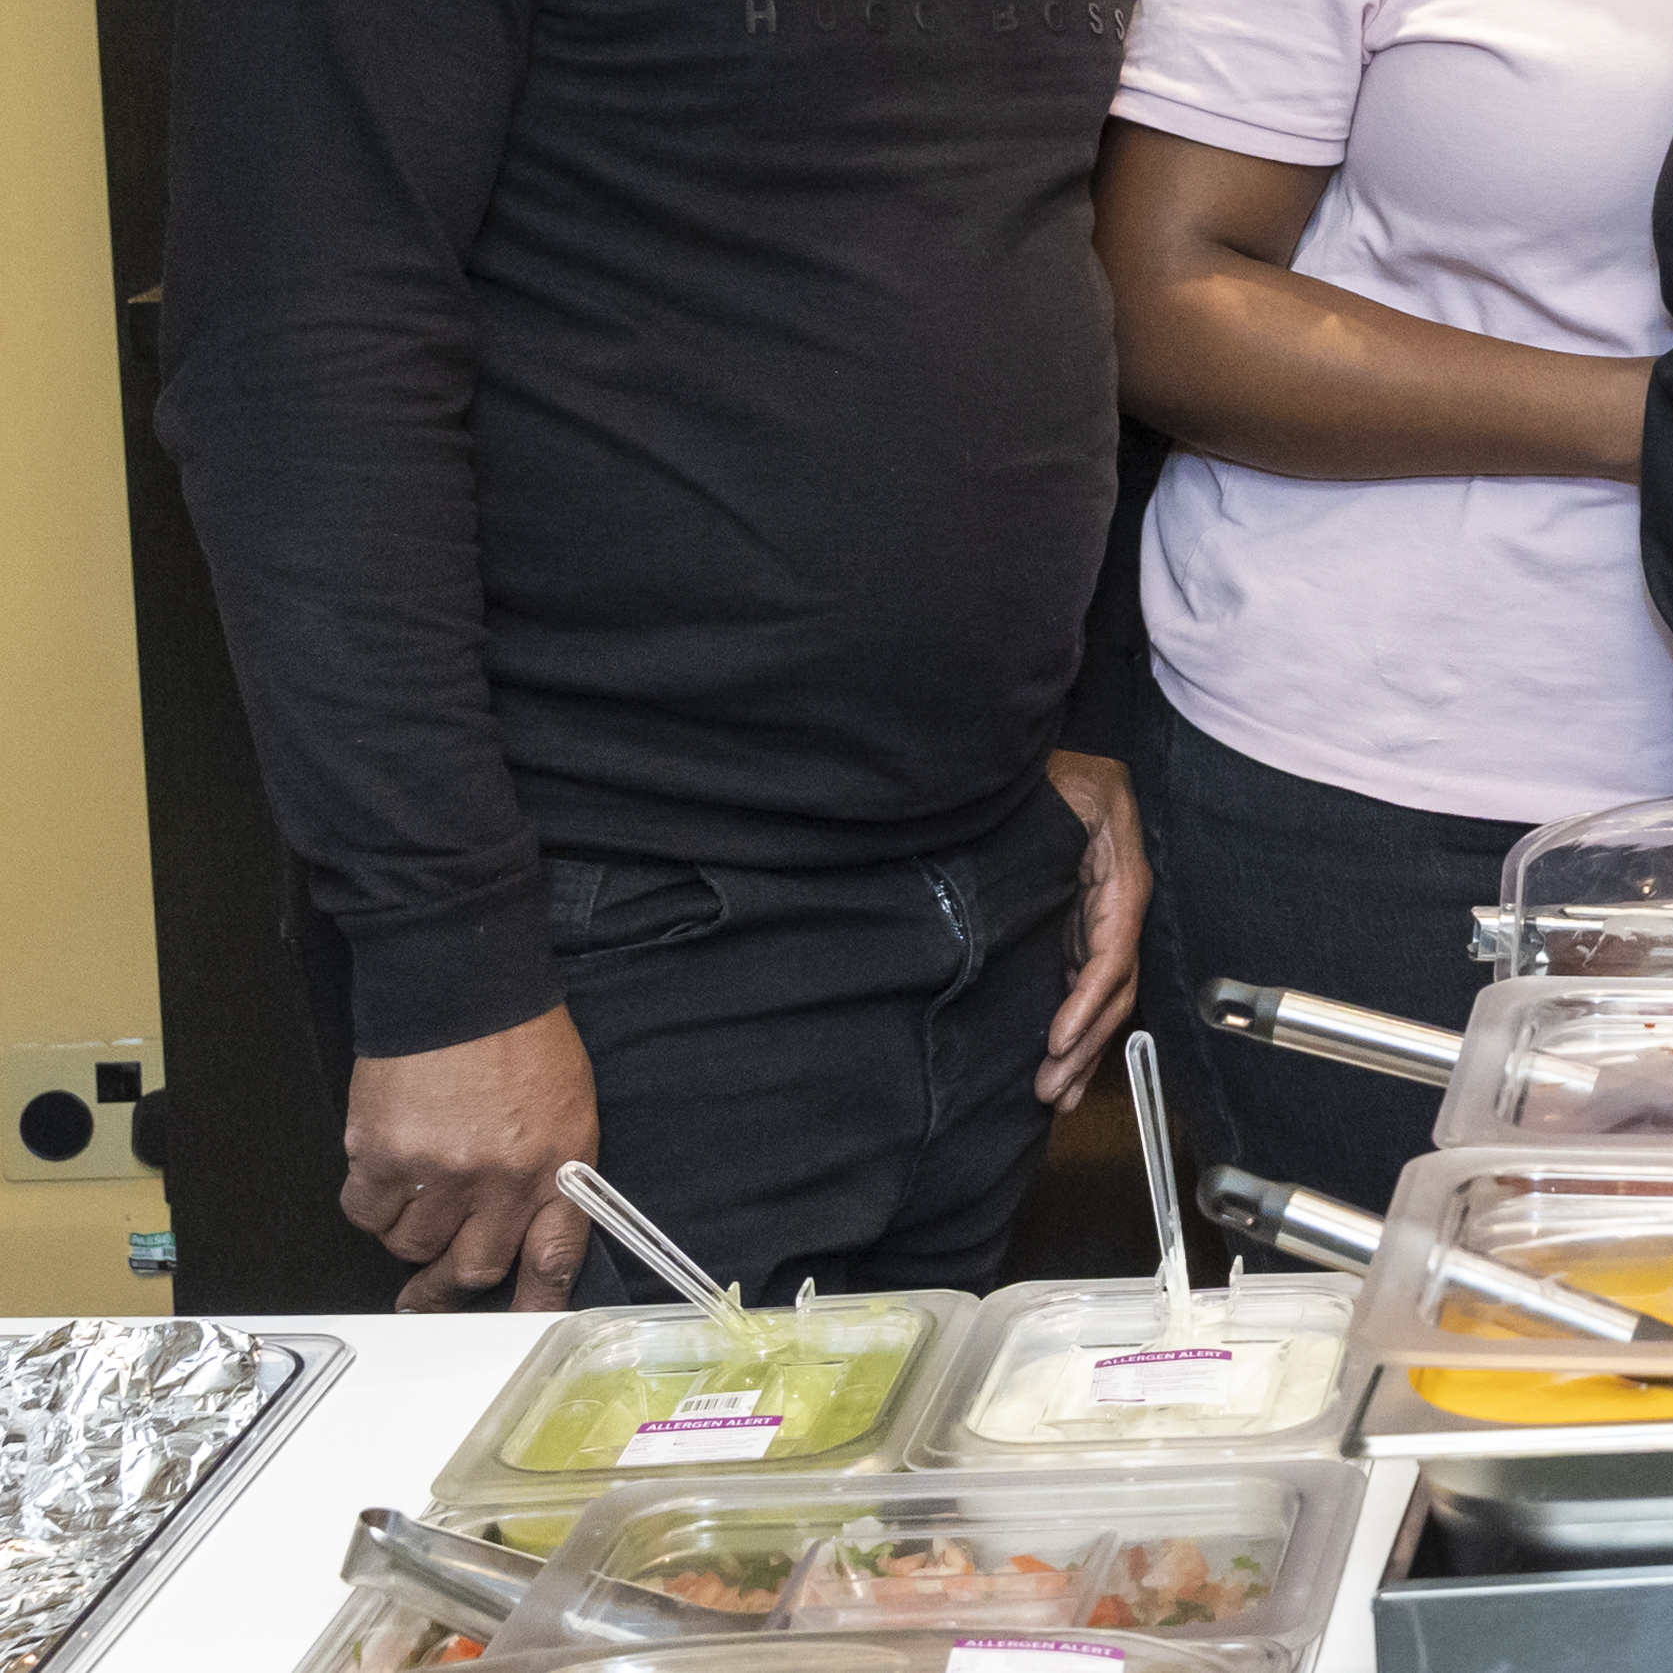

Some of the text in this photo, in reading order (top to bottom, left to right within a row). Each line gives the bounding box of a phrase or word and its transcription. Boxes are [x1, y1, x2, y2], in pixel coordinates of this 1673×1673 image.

[1102, 1350, 1224, 1366] ALLERGEN ALERT
[646, 1417, 773, 1432] ALLERGEN ALERT
